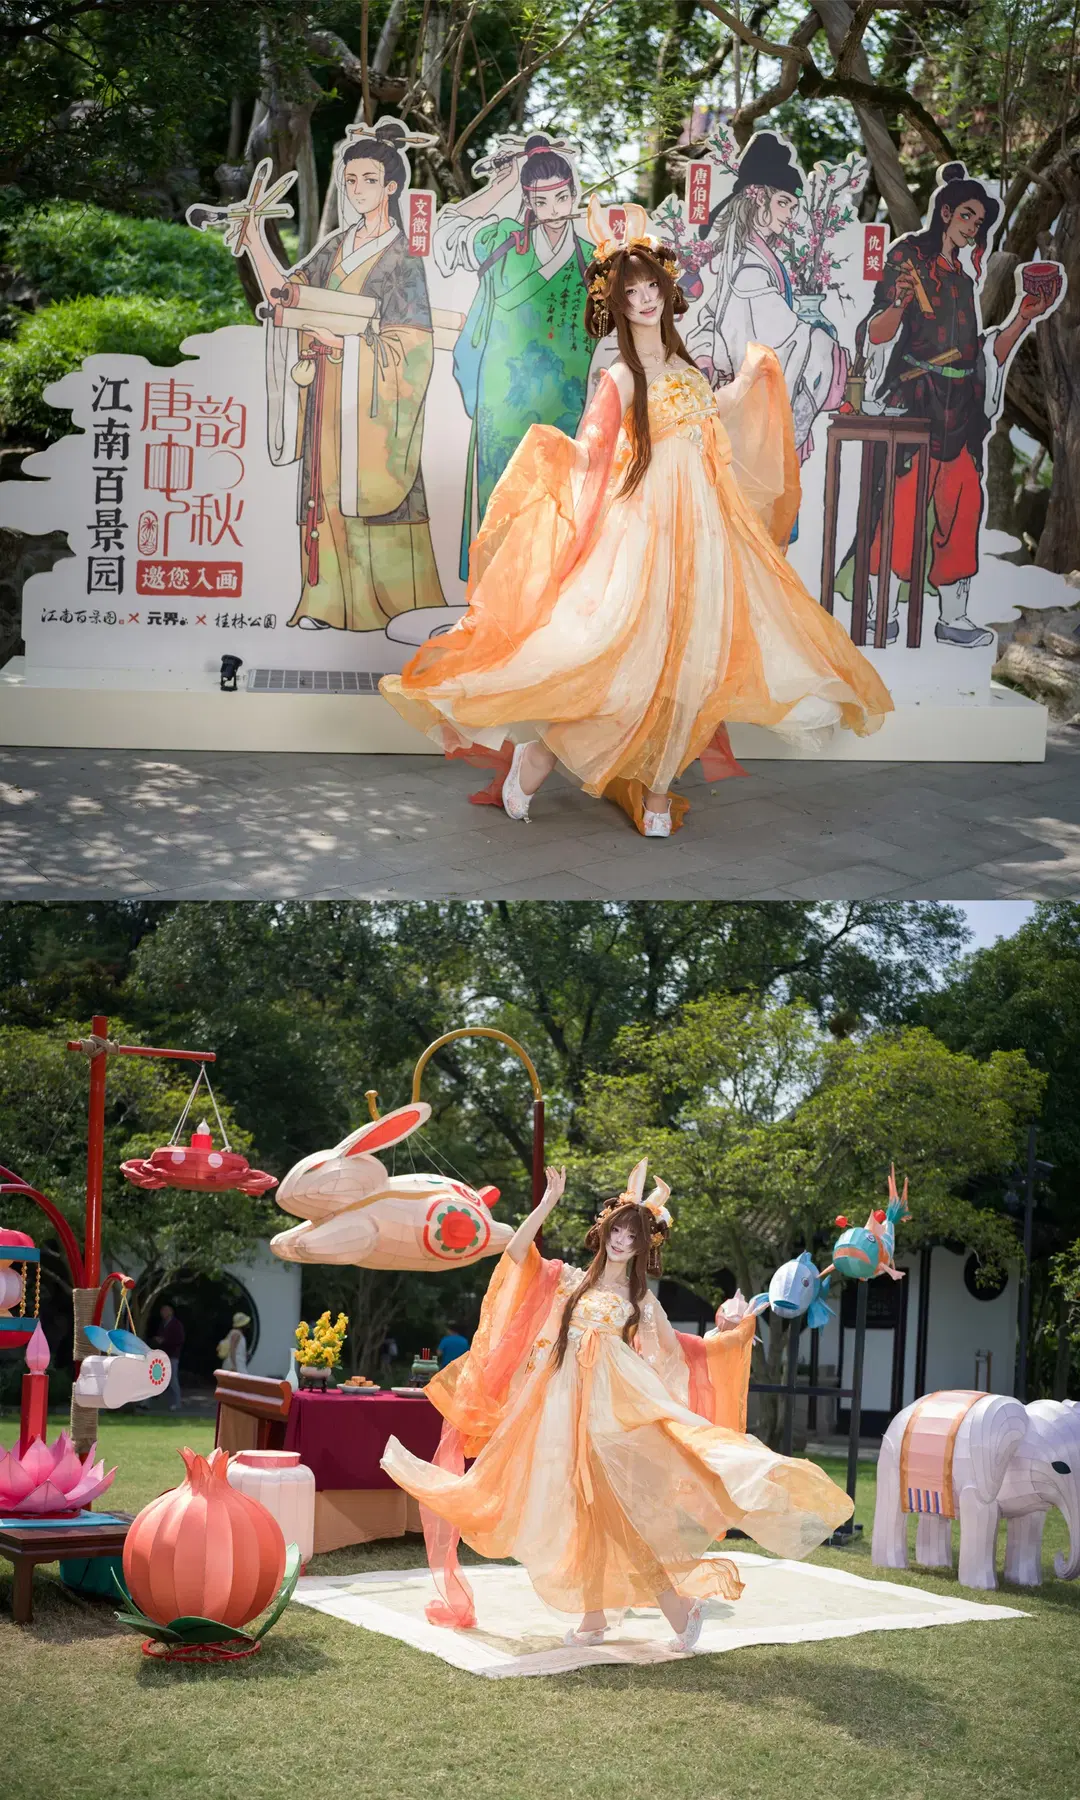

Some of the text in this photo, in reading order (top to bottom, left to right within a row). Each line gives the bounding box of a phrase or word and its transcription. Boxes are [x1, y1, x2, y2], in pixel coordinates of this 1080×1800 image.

[691, 167, 708, 221] 唐伯虎
[865, 235, 882, 272] 仇英
[140, 378, 247, 448] 唐韵
[86, 375, 133, 595] 江南百景园
[141, 566, 238, 591] 邀您入画
[147, 611, 178, 625] 元界
